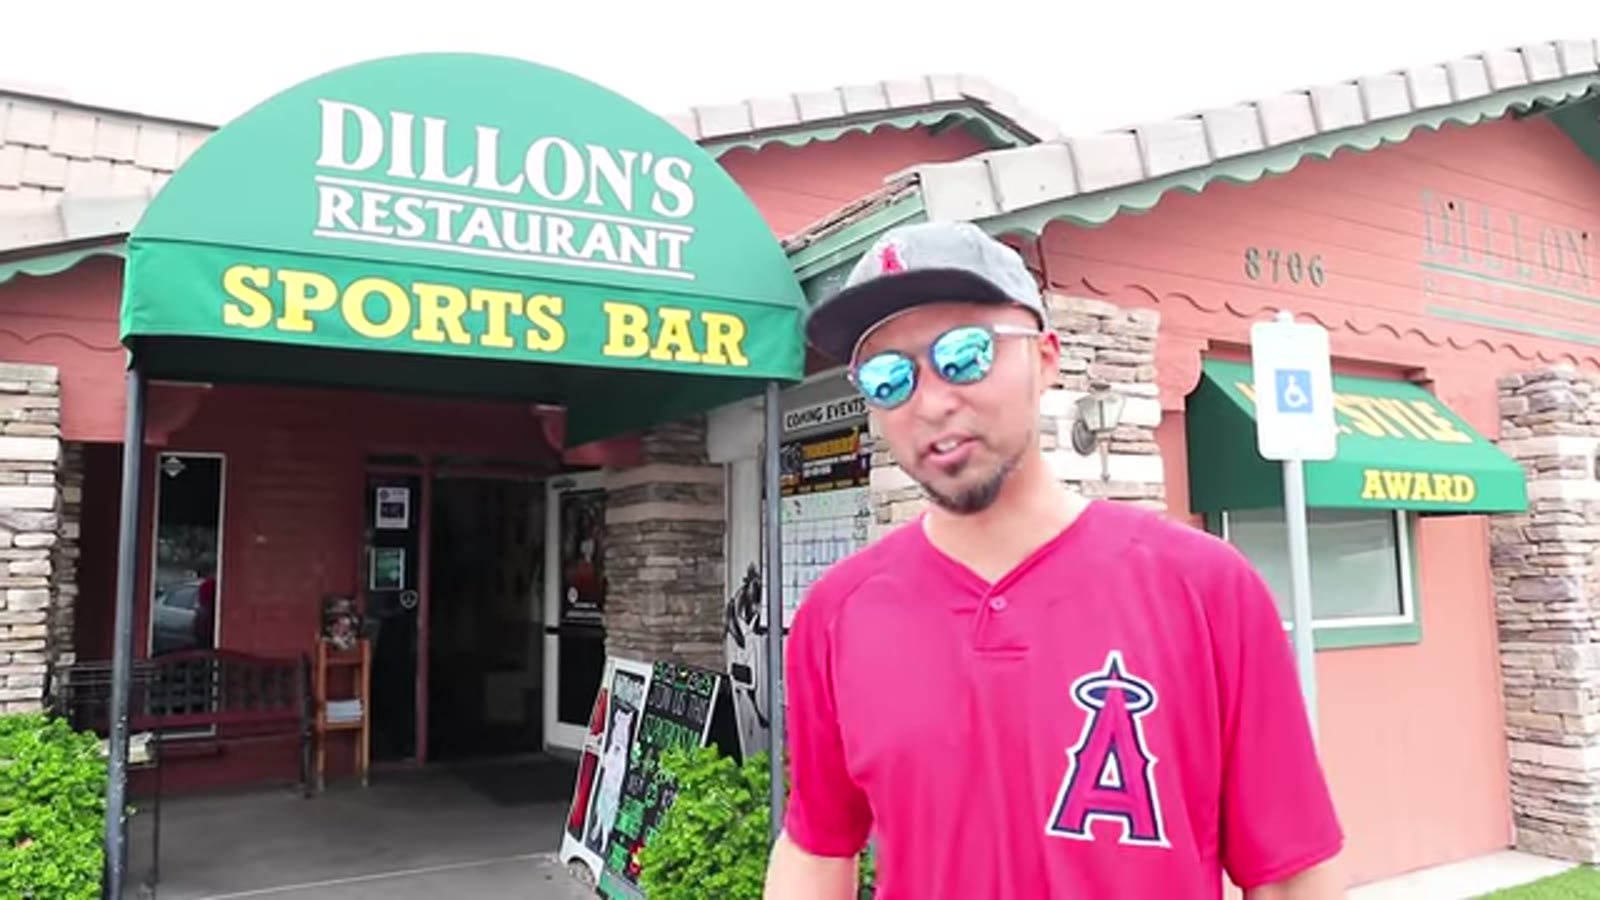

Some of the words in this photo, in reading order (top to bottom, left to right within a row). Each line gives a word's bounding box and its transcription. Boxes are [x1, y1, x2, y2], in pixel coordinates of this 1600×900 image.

[315, 98, 695, 218] DILLON'S
[316, 187, 695, 270] RESTAURANT
[1244, 247, 1325, 287] 8706
[222, 264, 567, 352] SPORTS
[603, 301, 750, 367] BAR
[826, 397, 866, 420] EVENTS
[1335, 393, 1473, 443] STYLE
[1361, 469, 1476, 503] AWARD
